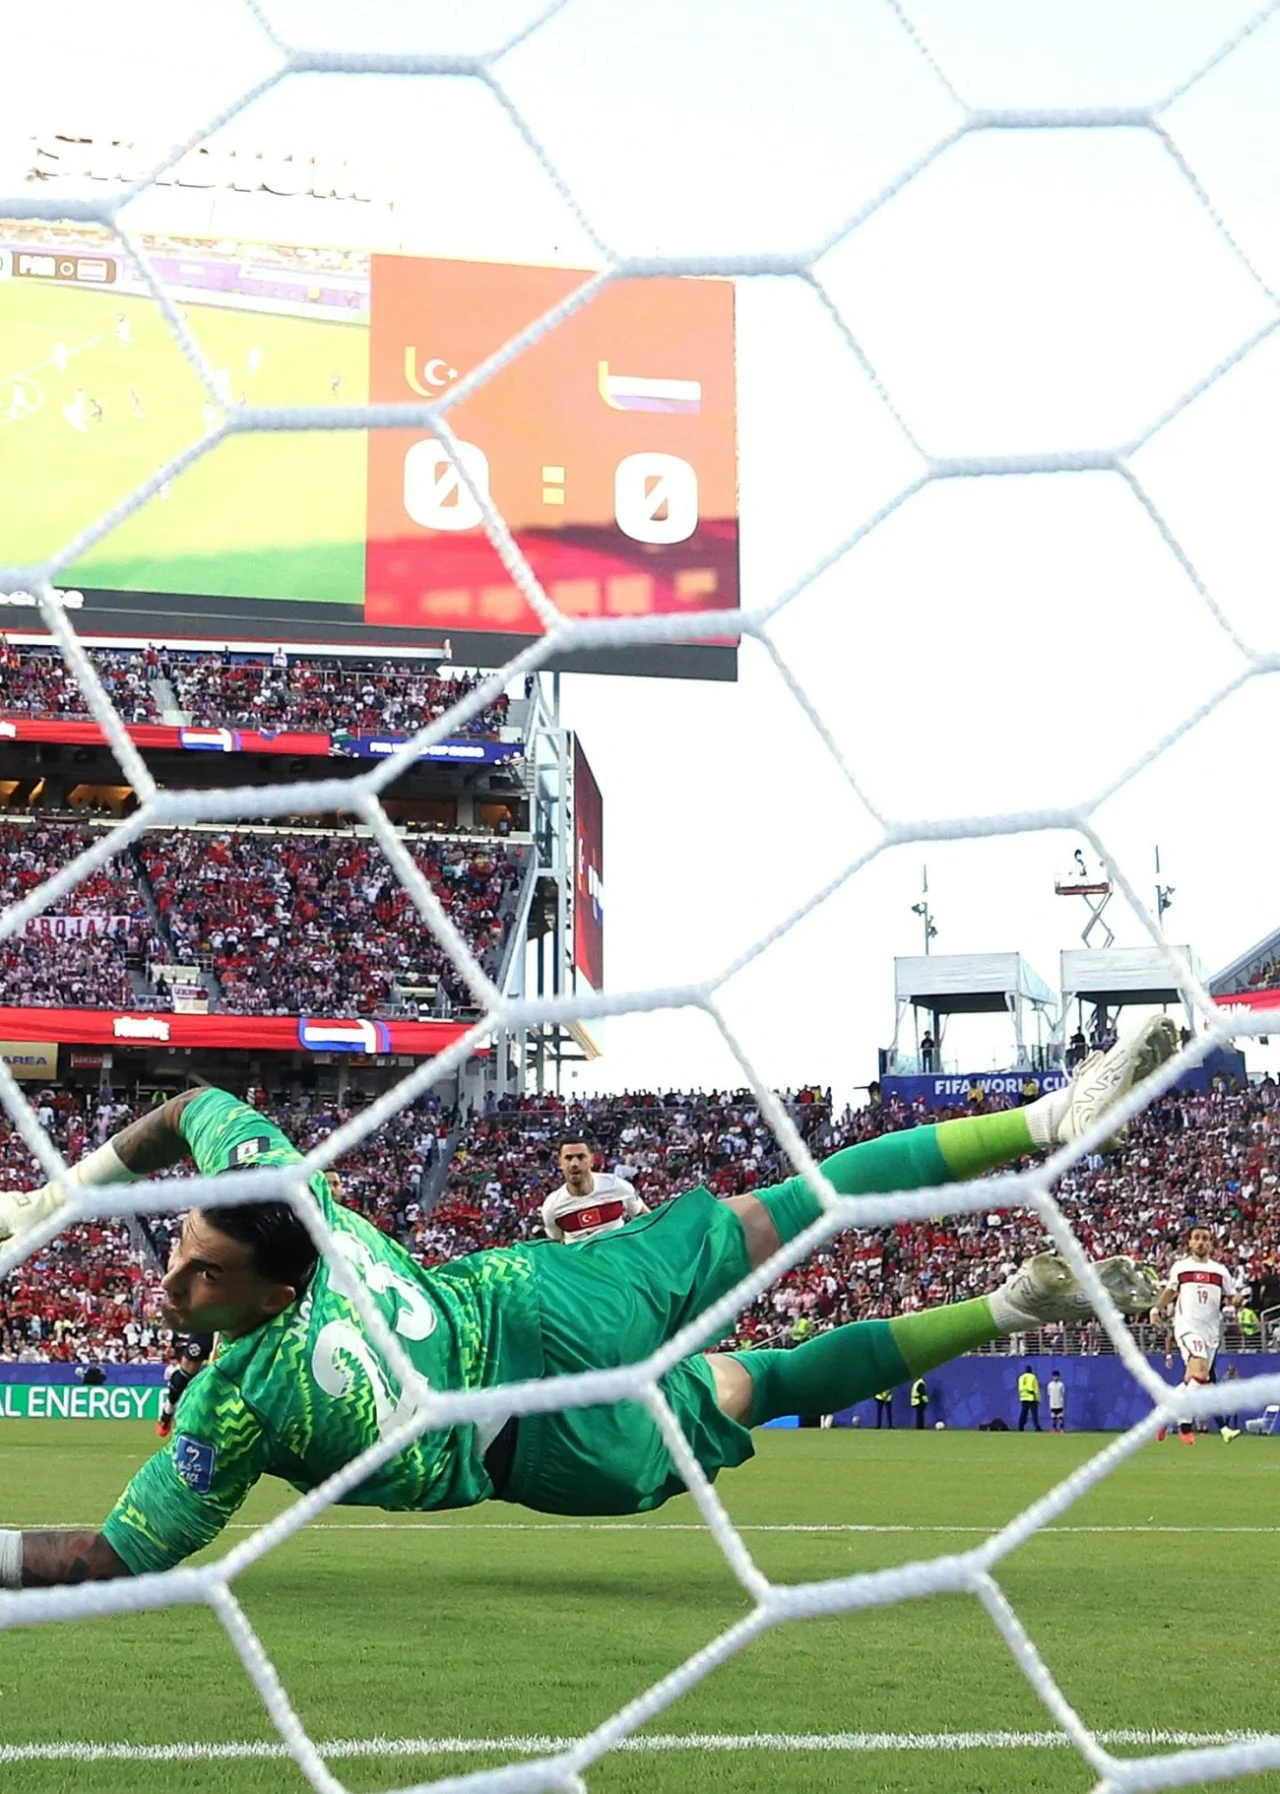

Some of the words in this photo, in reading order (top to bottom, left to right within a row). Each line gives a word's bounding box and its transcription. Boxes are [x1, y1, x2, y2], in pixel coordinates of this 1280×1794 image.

[403, 438, 490, 531] 0
[614, 452, 699, 545] 0
[934, 1079, 971, 1095] FIFA
[1197, 1290, 1209, 1305] 19
[27, 1385, 153, 1418] ENERGY
